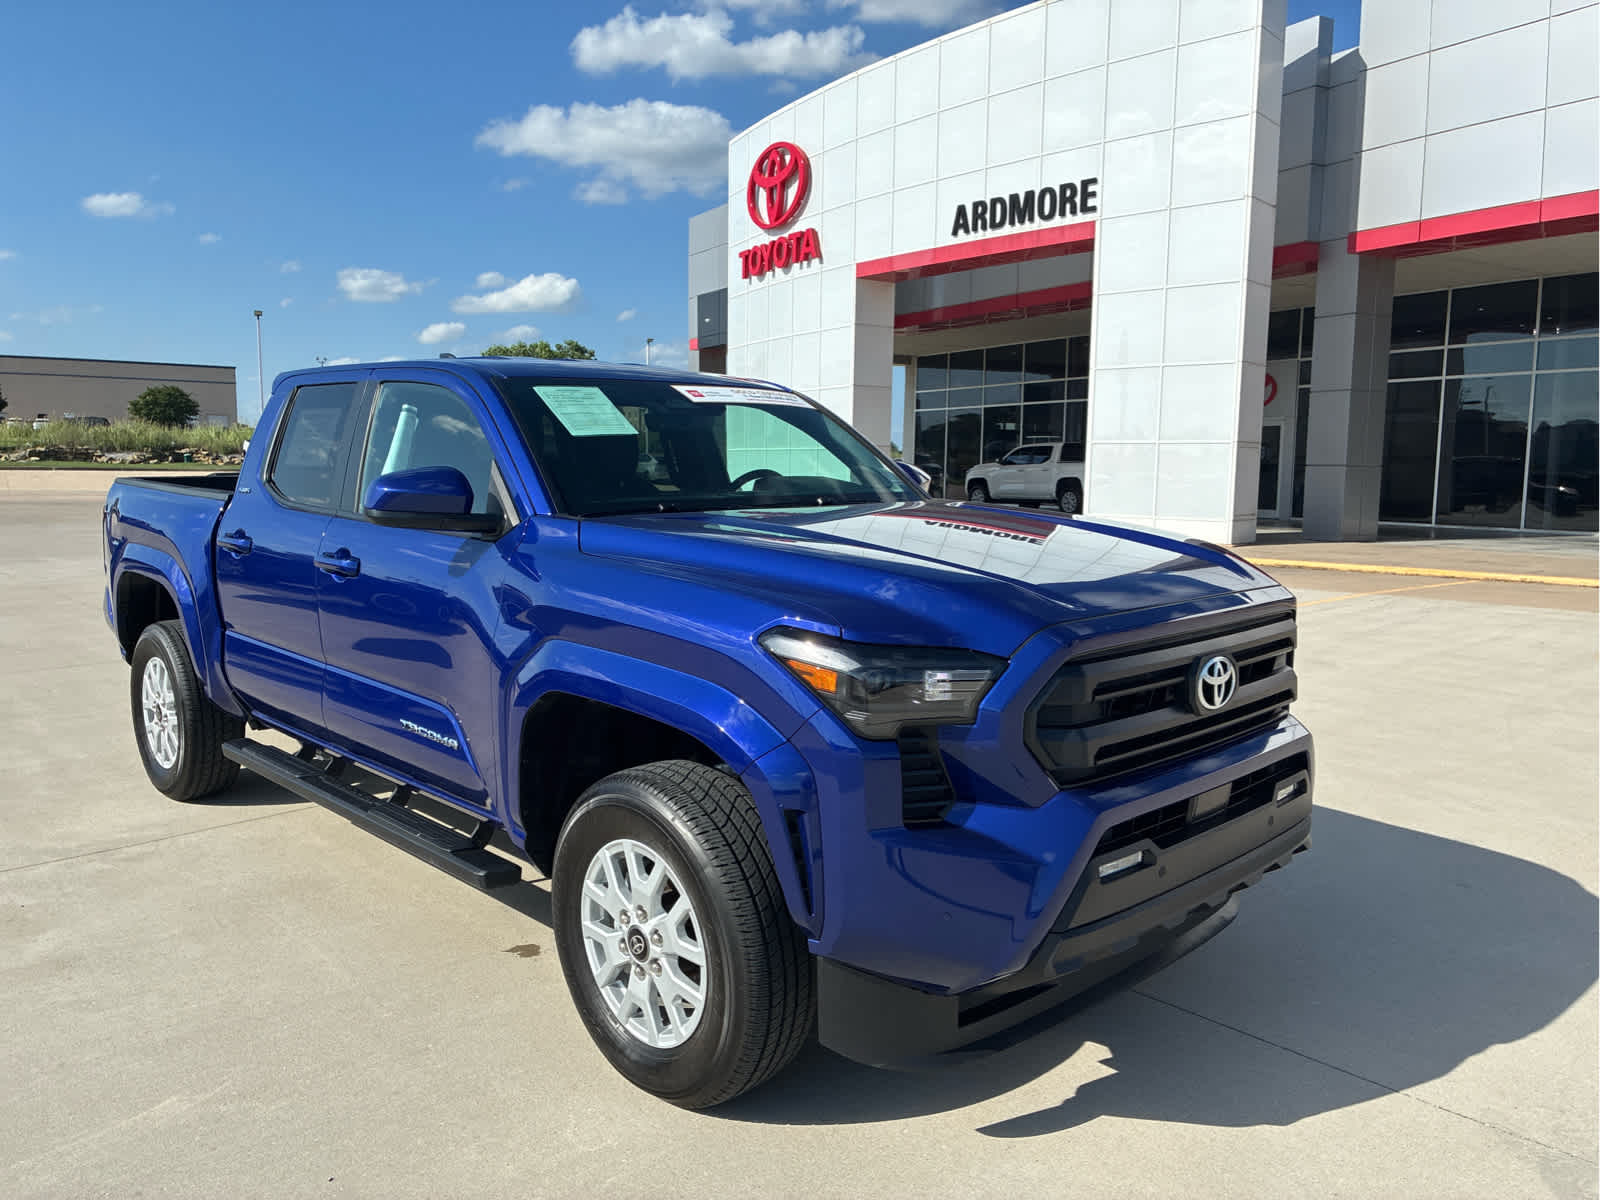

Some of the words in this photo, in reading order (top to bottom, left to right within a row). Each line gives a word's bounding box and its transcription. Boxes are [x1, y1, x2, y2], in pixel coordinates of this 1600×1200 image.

[951, 177, 1098, 237] ARDMORE
[738, 227, 822, 280] TOYOTA
[399, 718, 459, 751] TACOMA
